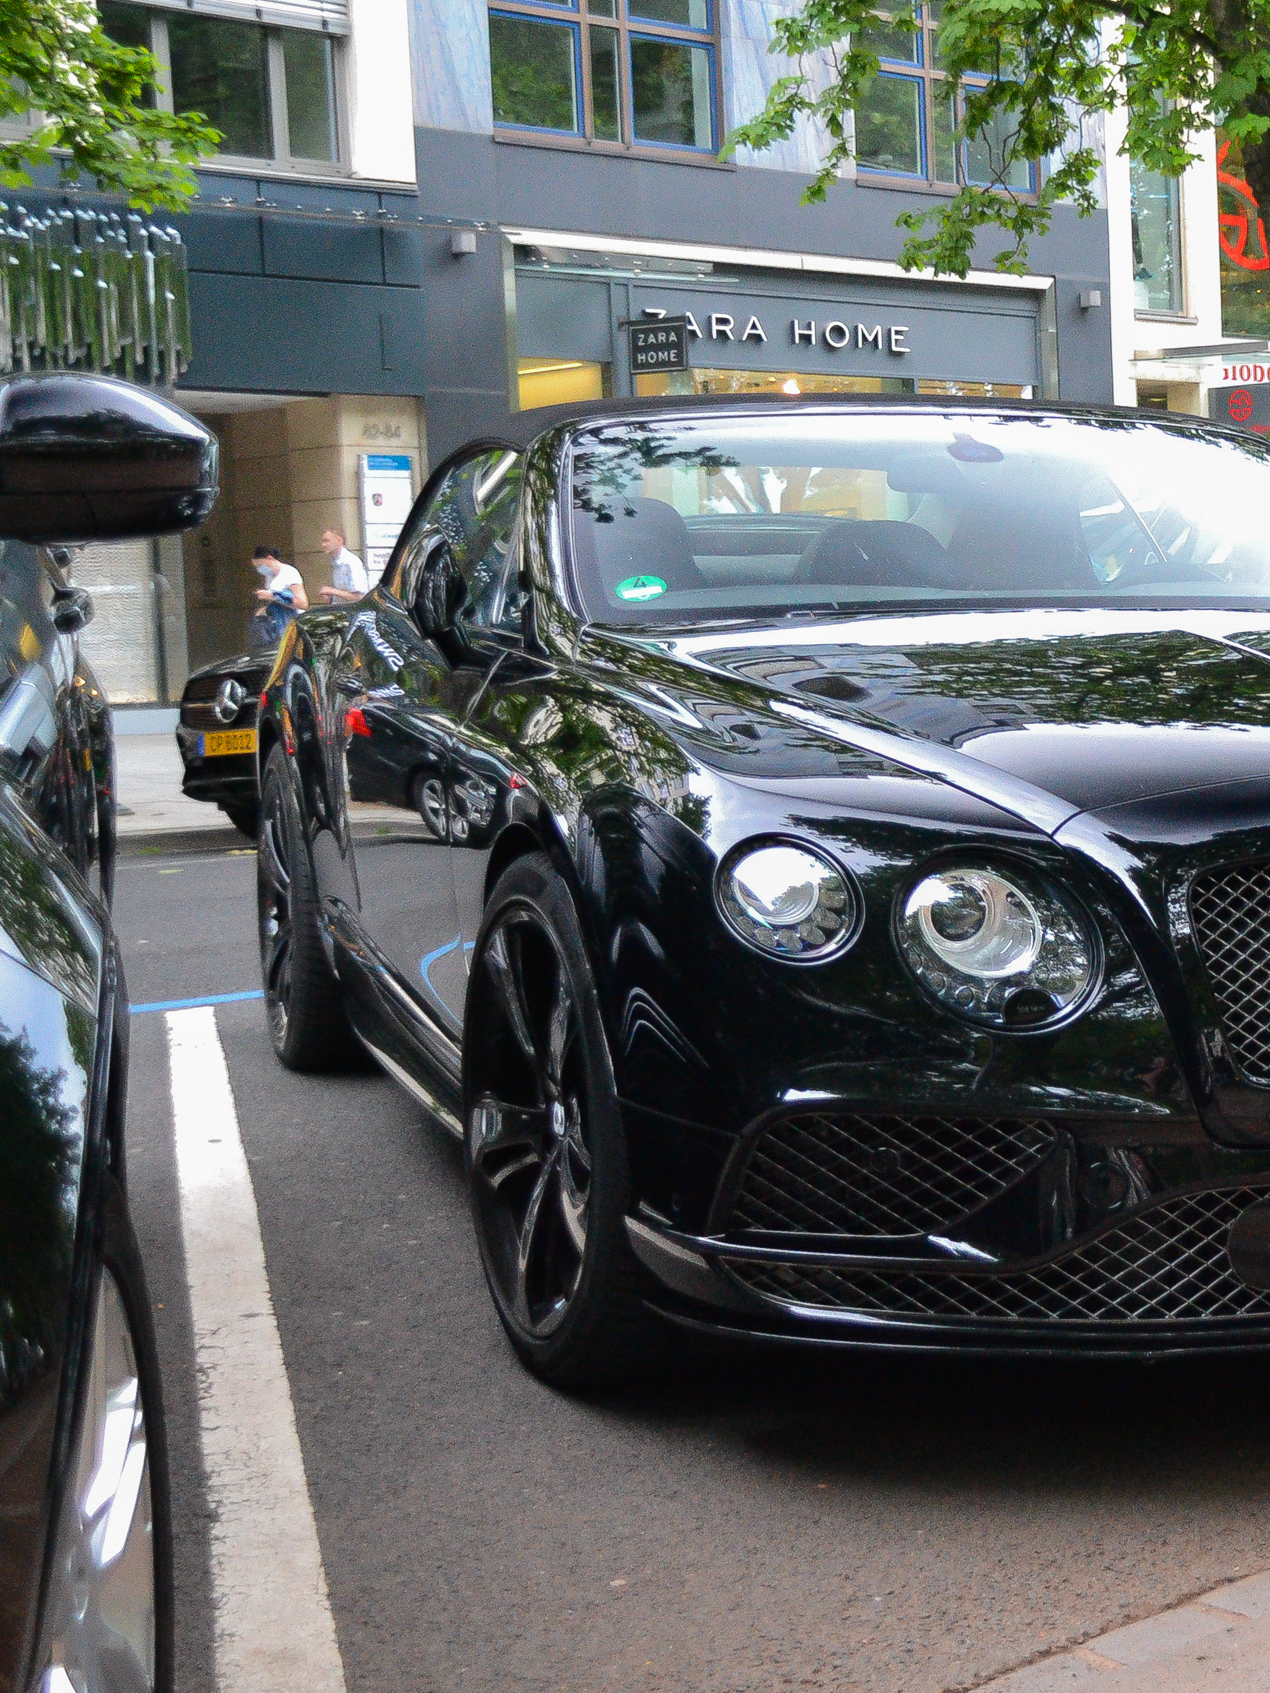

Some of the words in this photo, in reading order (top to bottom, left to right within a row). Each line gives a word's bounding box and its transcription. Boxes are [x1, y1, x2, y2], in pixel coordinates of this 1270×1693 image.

[637, 331, 679, 347] ZARA
[794, 319, 911, 353] HOME
[637, 349, 679, 364] HOME
